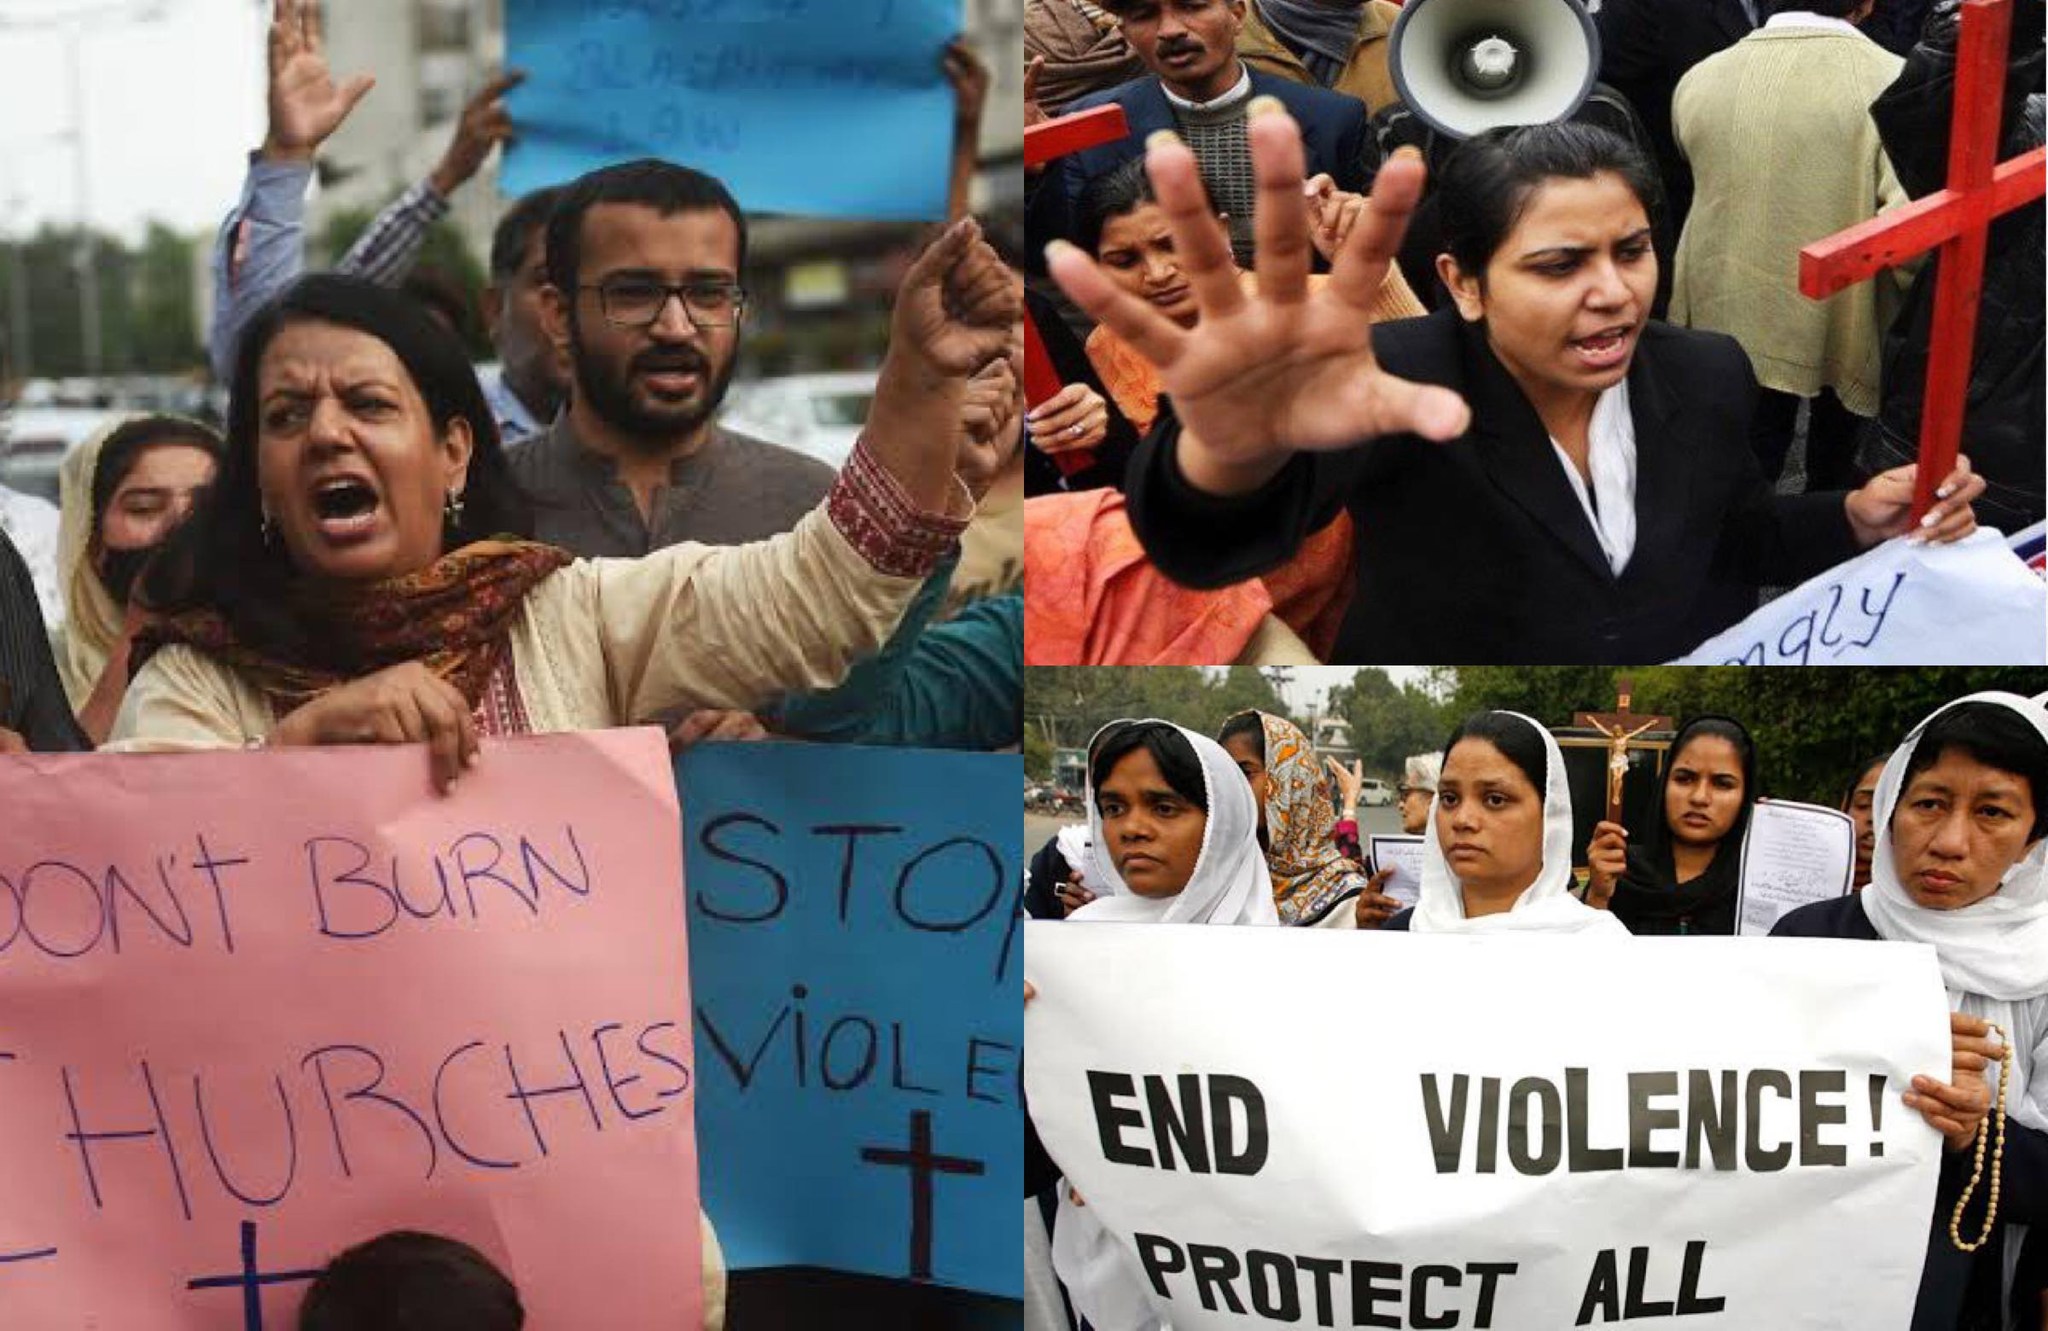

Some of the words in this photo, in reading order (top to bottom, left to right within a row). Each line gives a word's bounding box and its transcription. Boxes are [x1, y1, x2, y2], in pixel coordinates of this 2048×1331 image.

[305, 824, 592, 938] BURN
[696, 983, 1024, 1111] ViOLE
[0, 1022, 690, 1221] HURCHES
[1087, 1071, 1268, 1175] END
[1421, 1068, 1887, 1175] VIOLENCE!
[1134, 1233, 1518, 1329] PROTECT
[1577, 1241, 1725, 1320] ALL
